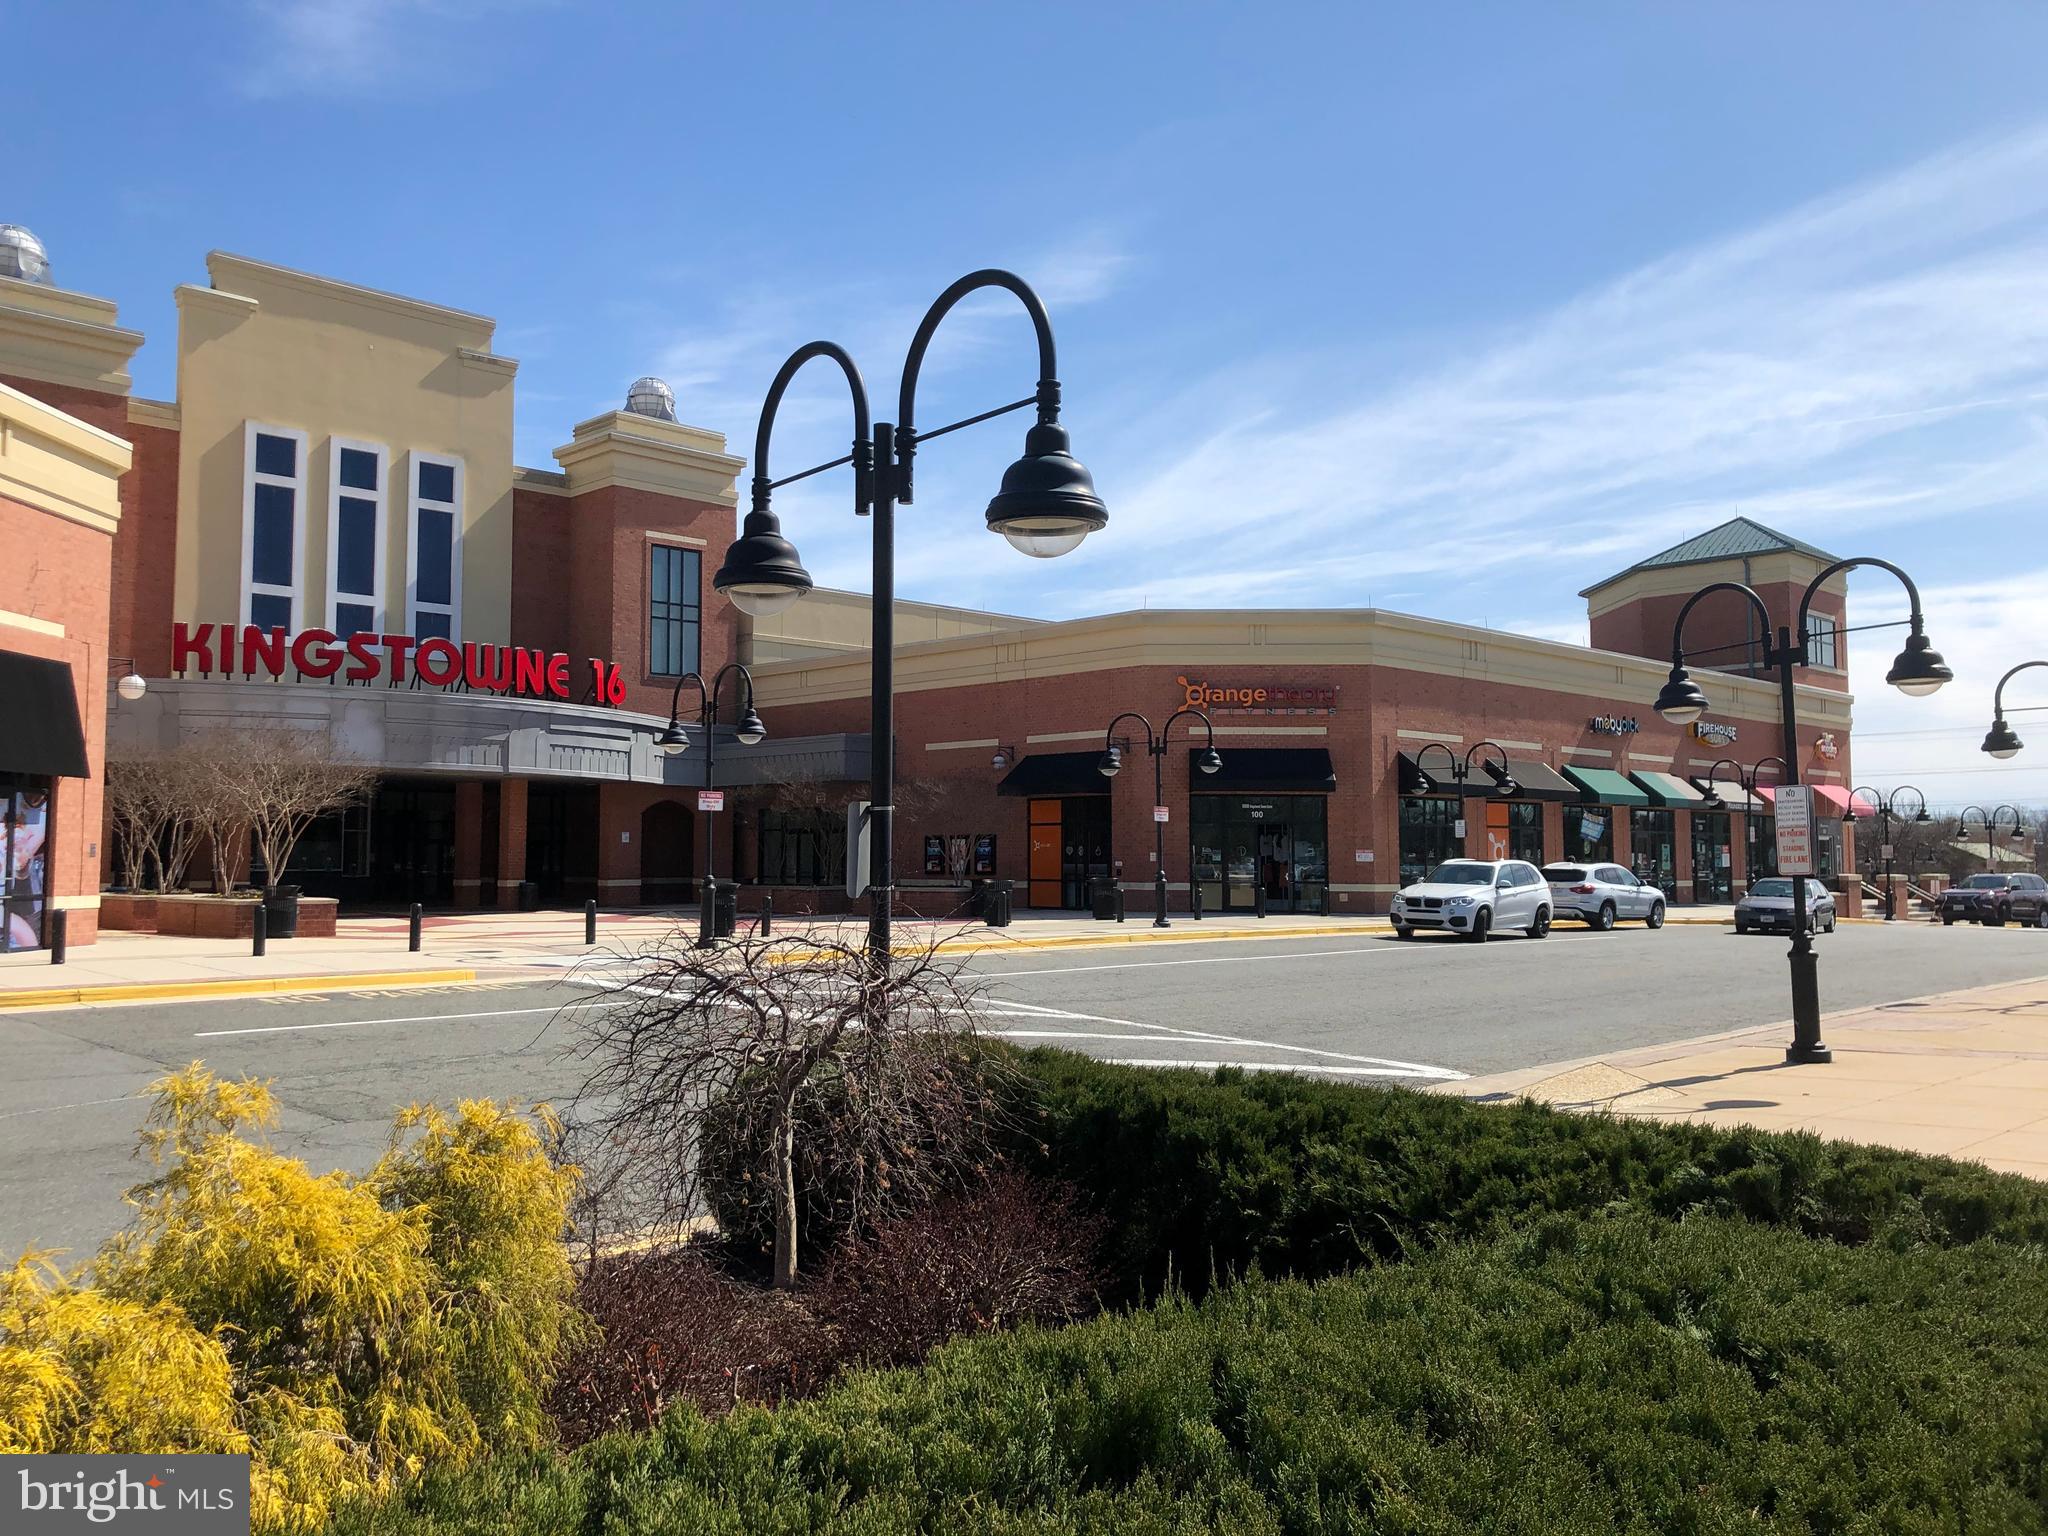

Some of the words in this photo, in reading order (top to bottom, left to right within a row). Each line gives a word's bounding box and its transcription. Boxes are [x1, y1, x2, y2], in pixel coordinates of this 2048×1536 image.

[173, 622, 570, 698] KINGSTOWNE
[589, 657, 627, 706] 16
[1210, 708, 1337, 716] FITNESS
[1698, 721, 1737, 742] FIREHOUSE
[1786, 789, 1796, 797] NO
[1780, 855, 1792, 864] FIRE
[1794, 855, 1808, 864] LANE
